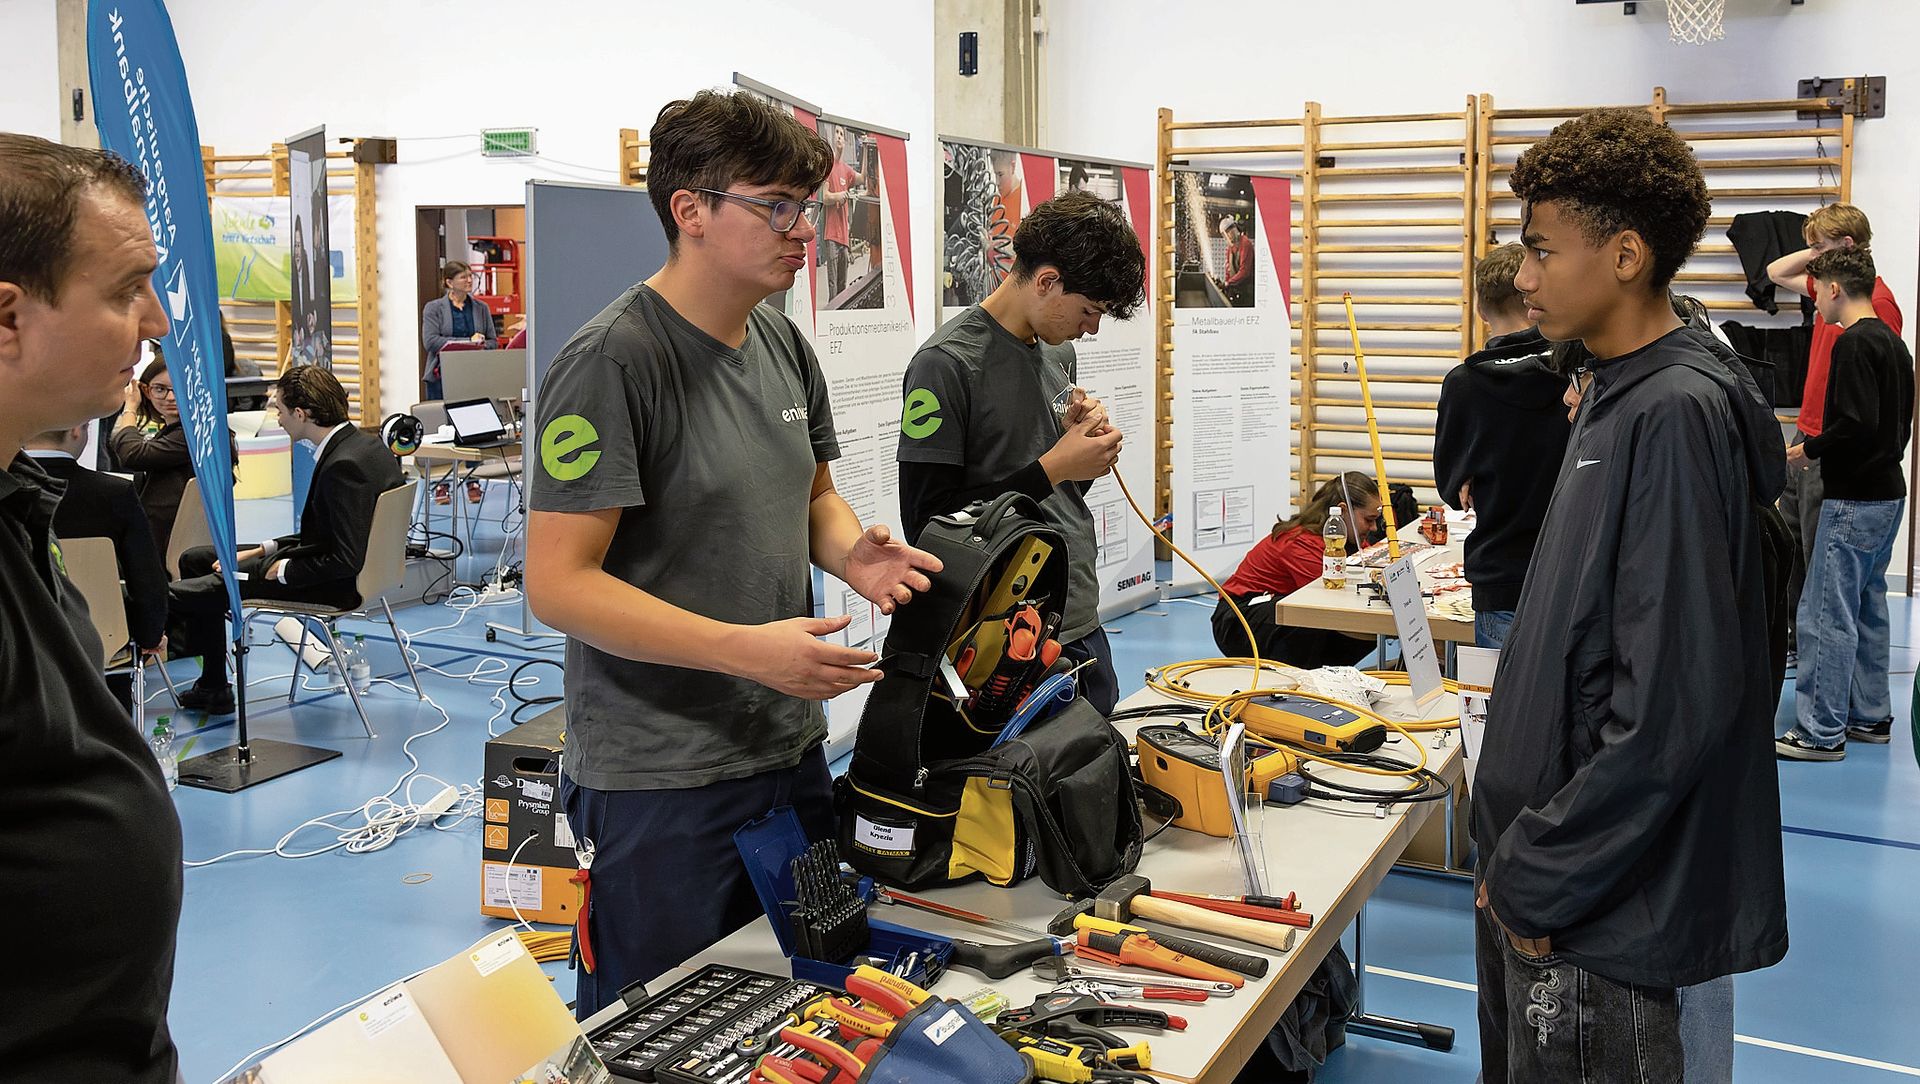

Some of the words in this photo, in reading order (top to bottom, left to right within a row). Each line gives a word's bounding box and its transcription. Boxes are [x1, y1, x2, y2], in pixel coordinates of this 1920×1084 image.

[1246, 315, 1260, 325] EFZ
[829, 341, 842, 355] EFZ
[902, 387, 943, 439] e
[541, 414, 602, 482] e
[1140, 571, 1152, 584] AG
[518, 799, 550, 810] Prysmian
[531, 808, 550, 817] Group
[880, 975, 914, 996] Bugnard
